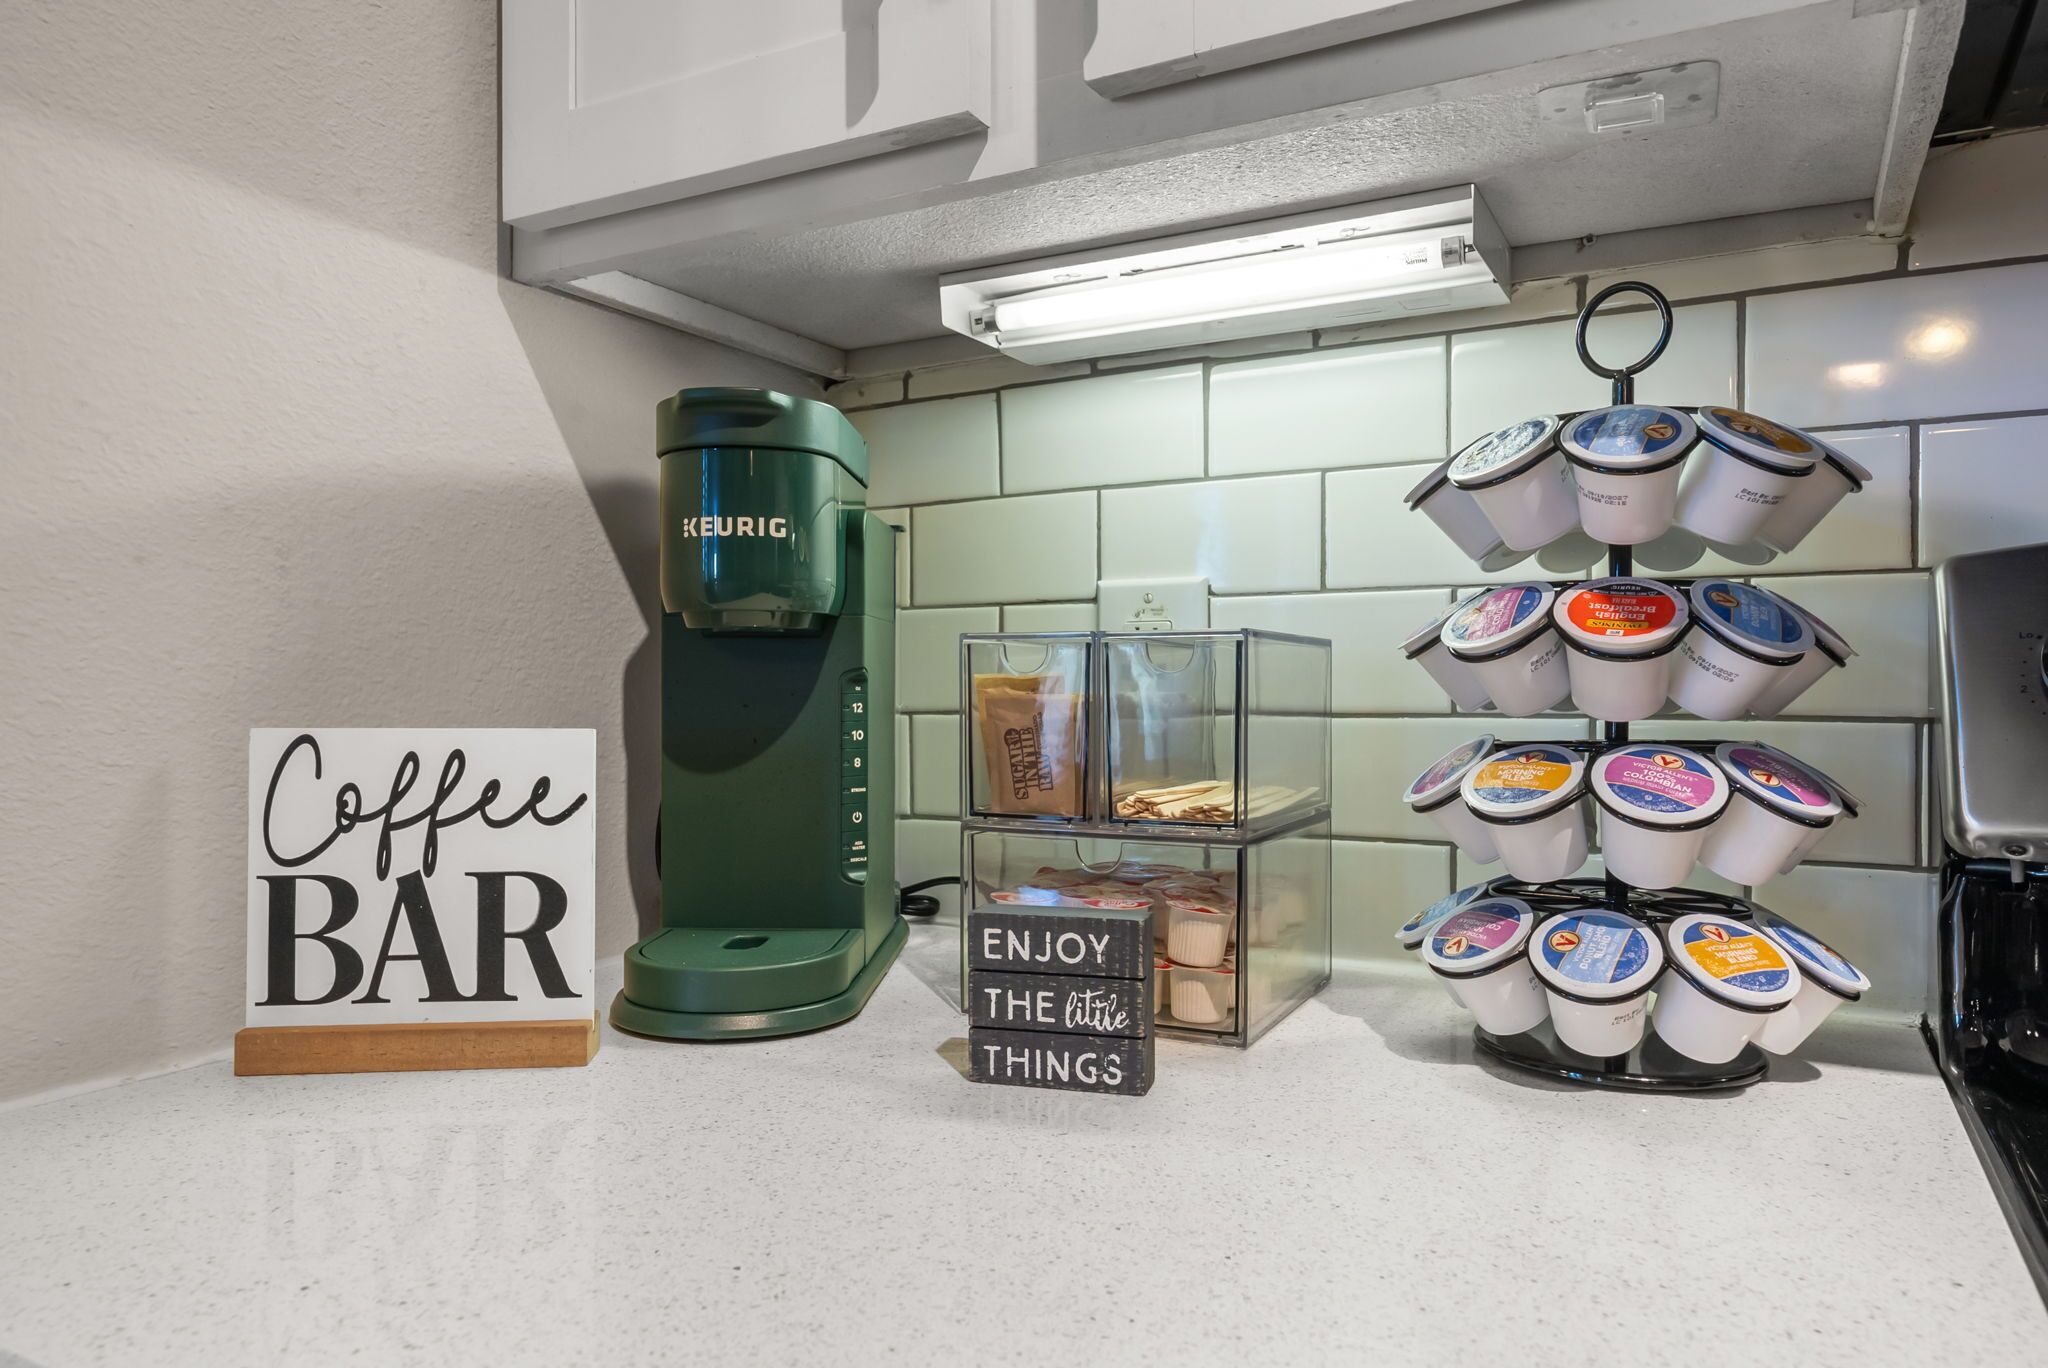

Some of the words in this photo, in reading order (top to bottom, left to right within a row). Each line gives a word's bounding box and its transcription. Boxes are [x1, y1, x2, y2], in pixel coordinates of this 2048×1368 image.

[683, 516, 787, 538] KEURIG
[1588, 602, 1657, 613] Breakfast
[1595, 611, 1646, 620] English
[2019, 631, 2034, 639] Lo
[852, 702, 863, 713] 12
[851, 729, 864, 741] 10
[853, 757, 861, 768] 8
[1008, 741, 1028, 799] SUGAR
[1496, 768, 1545, 777] MORNING
[1632, 761, 1663, 772] VICTOR
[1623, 770, 1693, 794] COLOMBIAN
[1642, 769, 1677, 784] 100%
[263, 733, 588, 882] Coffee
[254, 869, 583, 1007] BAR
[983, 928, 1110, 964] ENJOY
[1594, 935, 1612, 959] BLEND
[1579, 943, 1597, 970] DONUT
[984, 988, 1056, 1023] THE
[1065, 988, 1129, 1032] little
[983, 1045, 1123, 1086] THINGS
